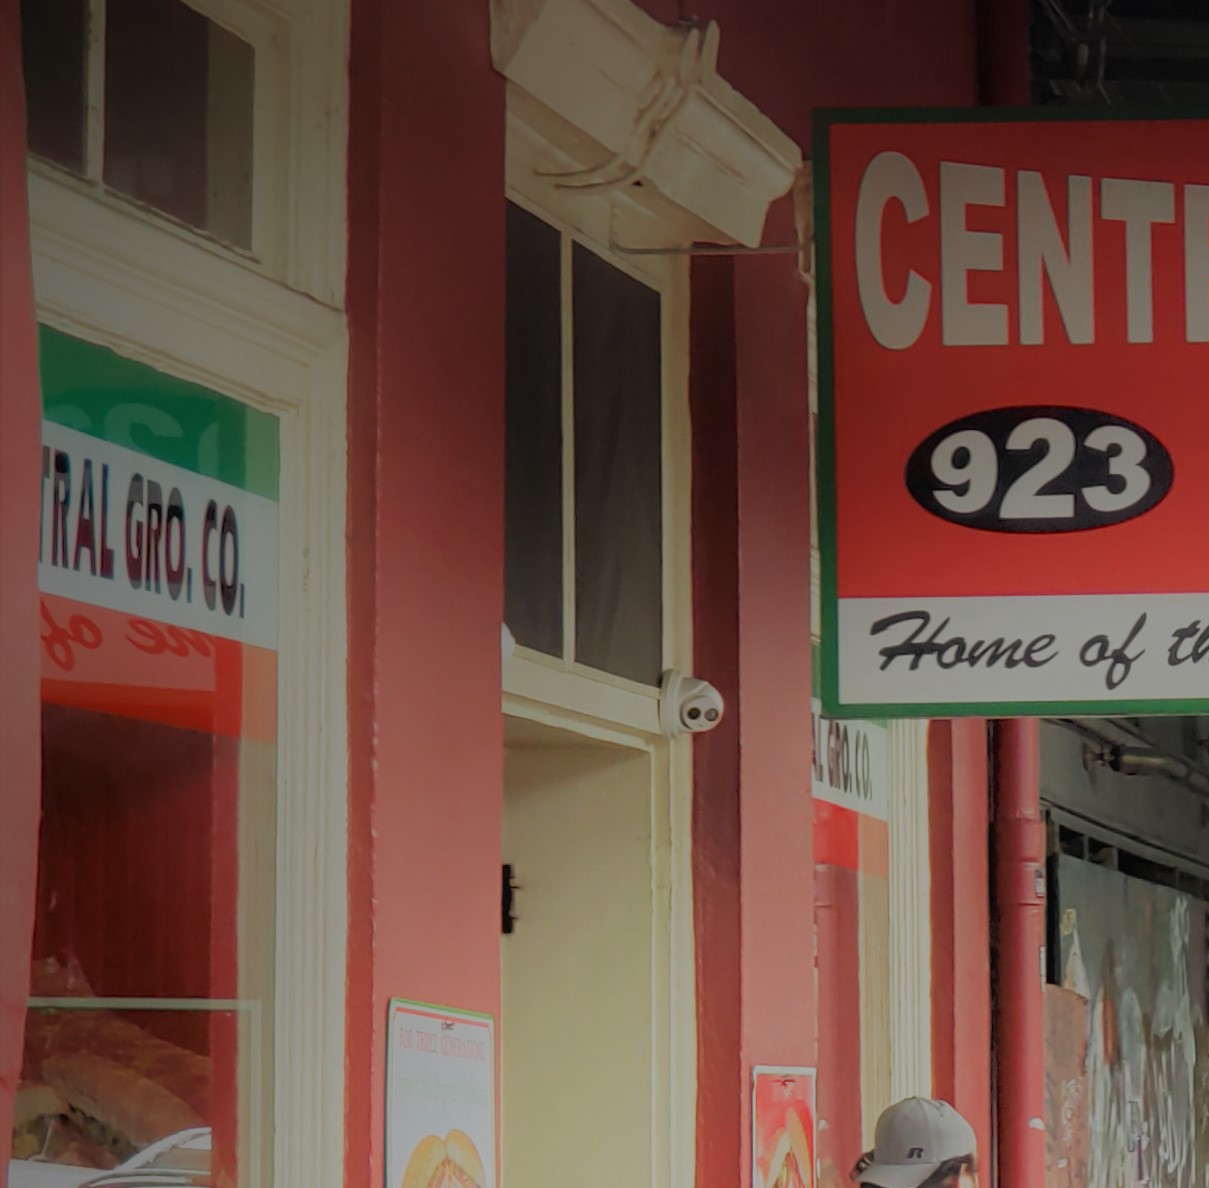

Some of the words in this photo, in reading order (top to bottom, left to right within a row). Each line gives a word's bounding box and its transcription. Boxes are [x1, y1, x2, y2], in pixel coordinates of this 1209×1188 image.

[930, 417, 1151, 519] 923
[125, 472, 192, 604] GRO.
[202, 498, 246, 619] CO.
[870, 610, 1059, 672] Home
[1079, 612, 1148, 690] of
